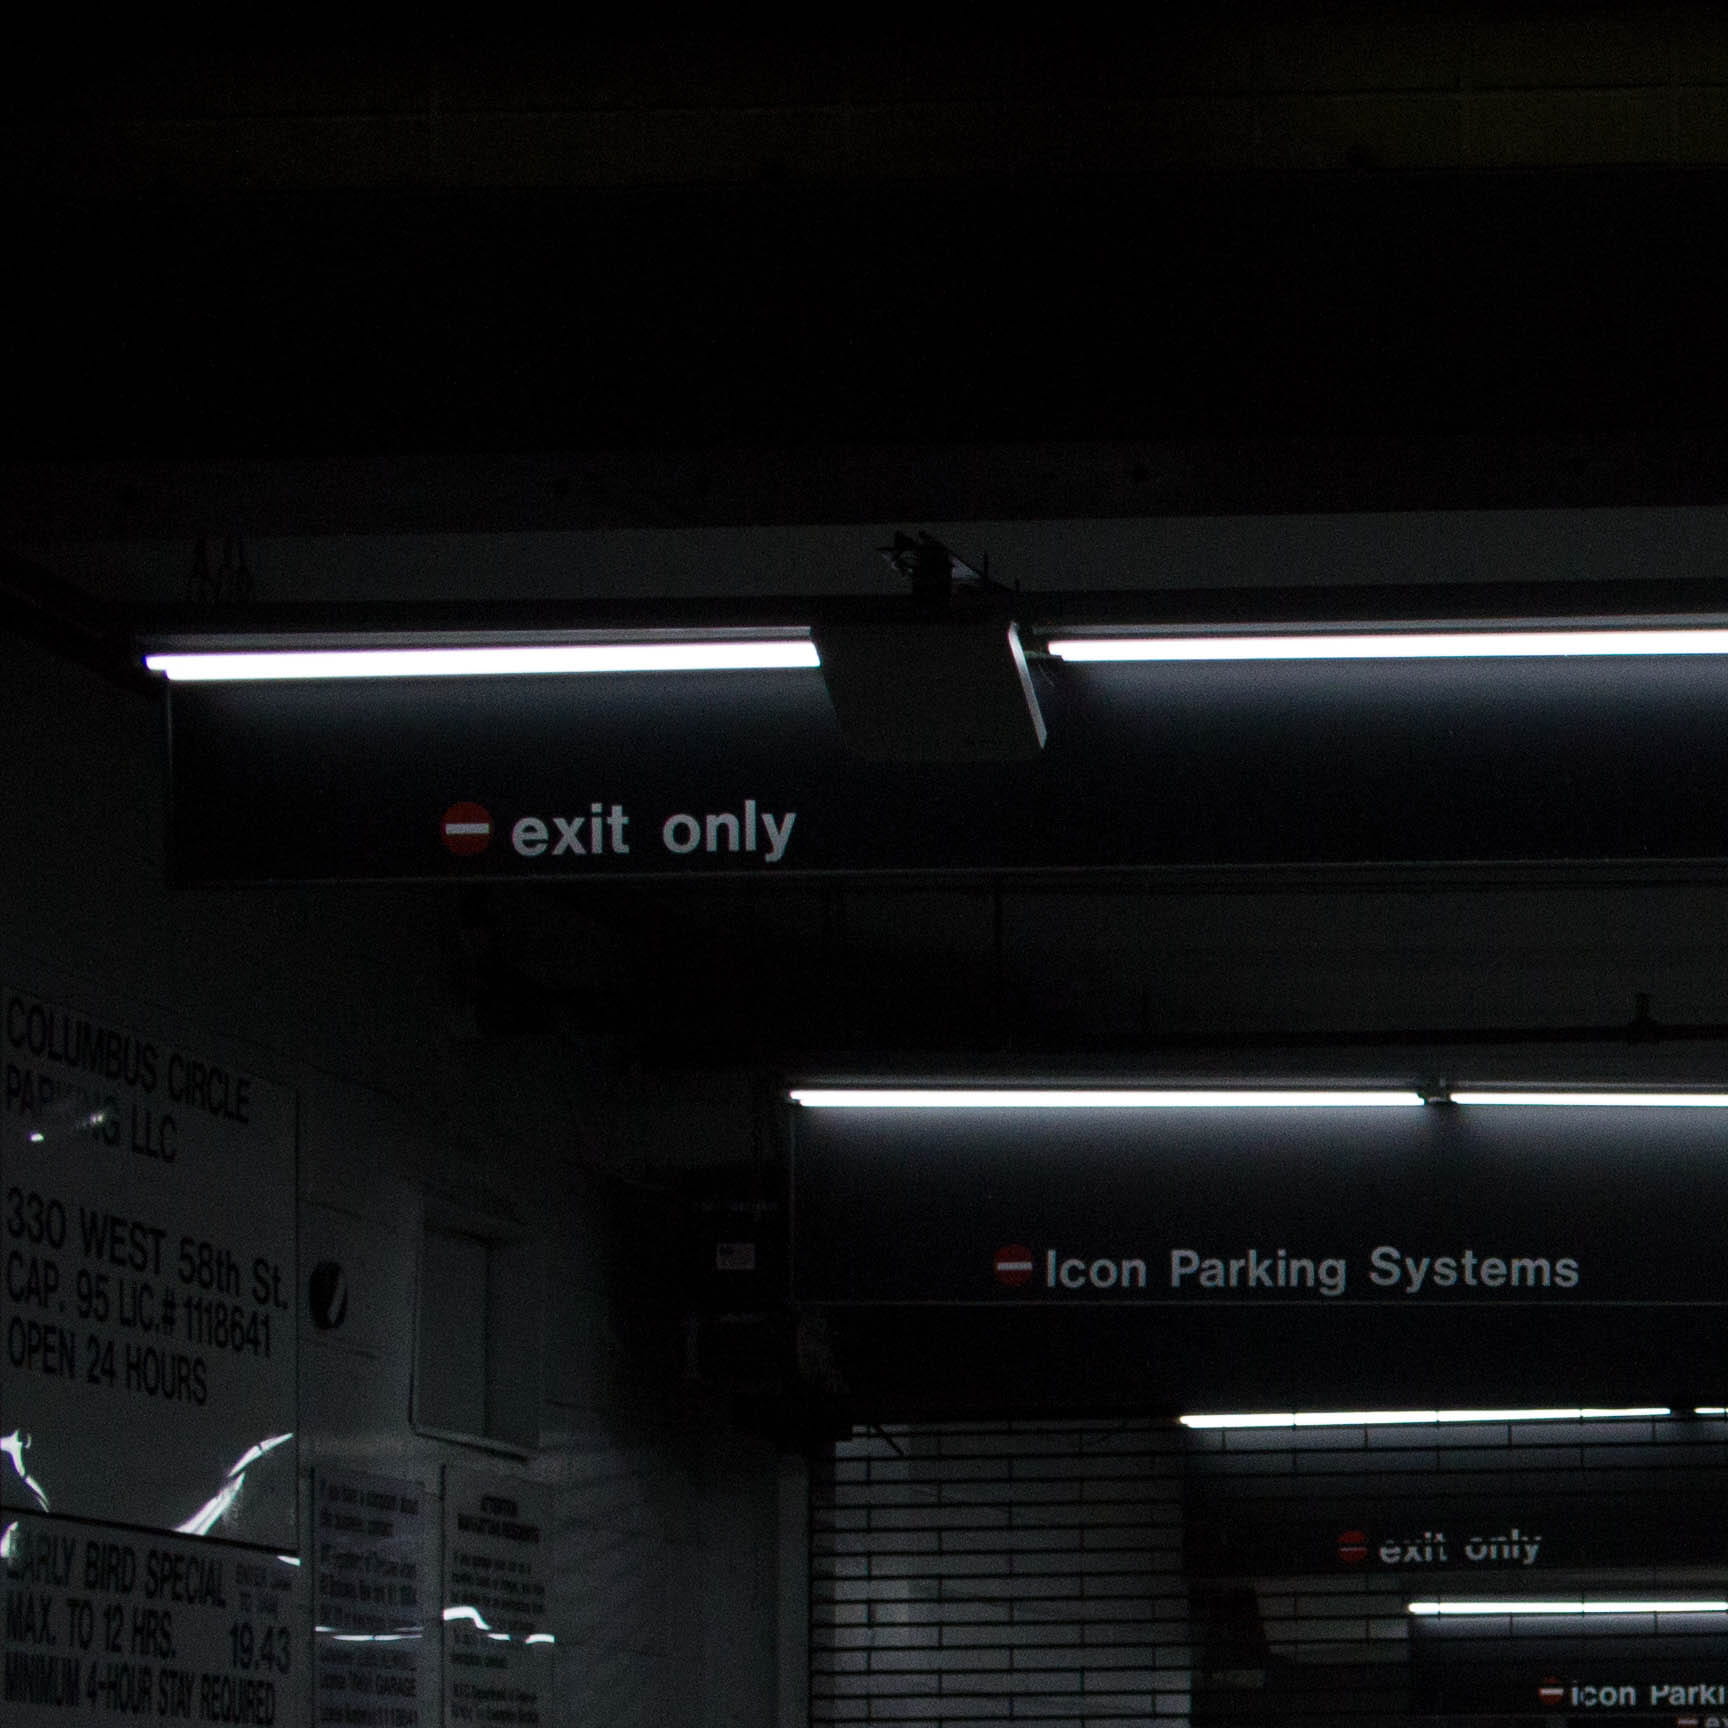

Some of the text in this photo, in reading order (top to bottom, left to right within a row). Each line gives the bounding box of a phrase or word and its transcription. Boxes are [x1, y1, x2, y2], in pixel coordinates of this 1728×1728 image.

[510, 799, 798, 864] exit only
[6, 996, 251, 1125] COLUMBUS CIRCLE
[131, 1103, 178, 1164] LLC
[6, 1185, 289, 1311] 330 WEST 58th St.
[1045, 1244, 1581, 1298] Icon Parking Systems
[5, 1249, 65, 1313] CAP.
[75, 1267, 111, 1323] 95
[7, 1315, 209, 1407] OPEN 24 HOURS
[83, 1540, 137, 1595] BIRD
[144, 1548, 228, 1610] SPECIAL
[1378, 1527, 1544, 1566] exit only
[66, 1597, 94, 1651] TO
[102, 1602, 125, 1653] 12
[131, 1606, 177, 1660] HRS.
[228, 1620, 292, 1675] 19.43
[4, 1651, 81, 1708] MINIMUM
[157, 1667, 195, 1719] STAY
[200, 1672, 277, 1727] REQUIRED
